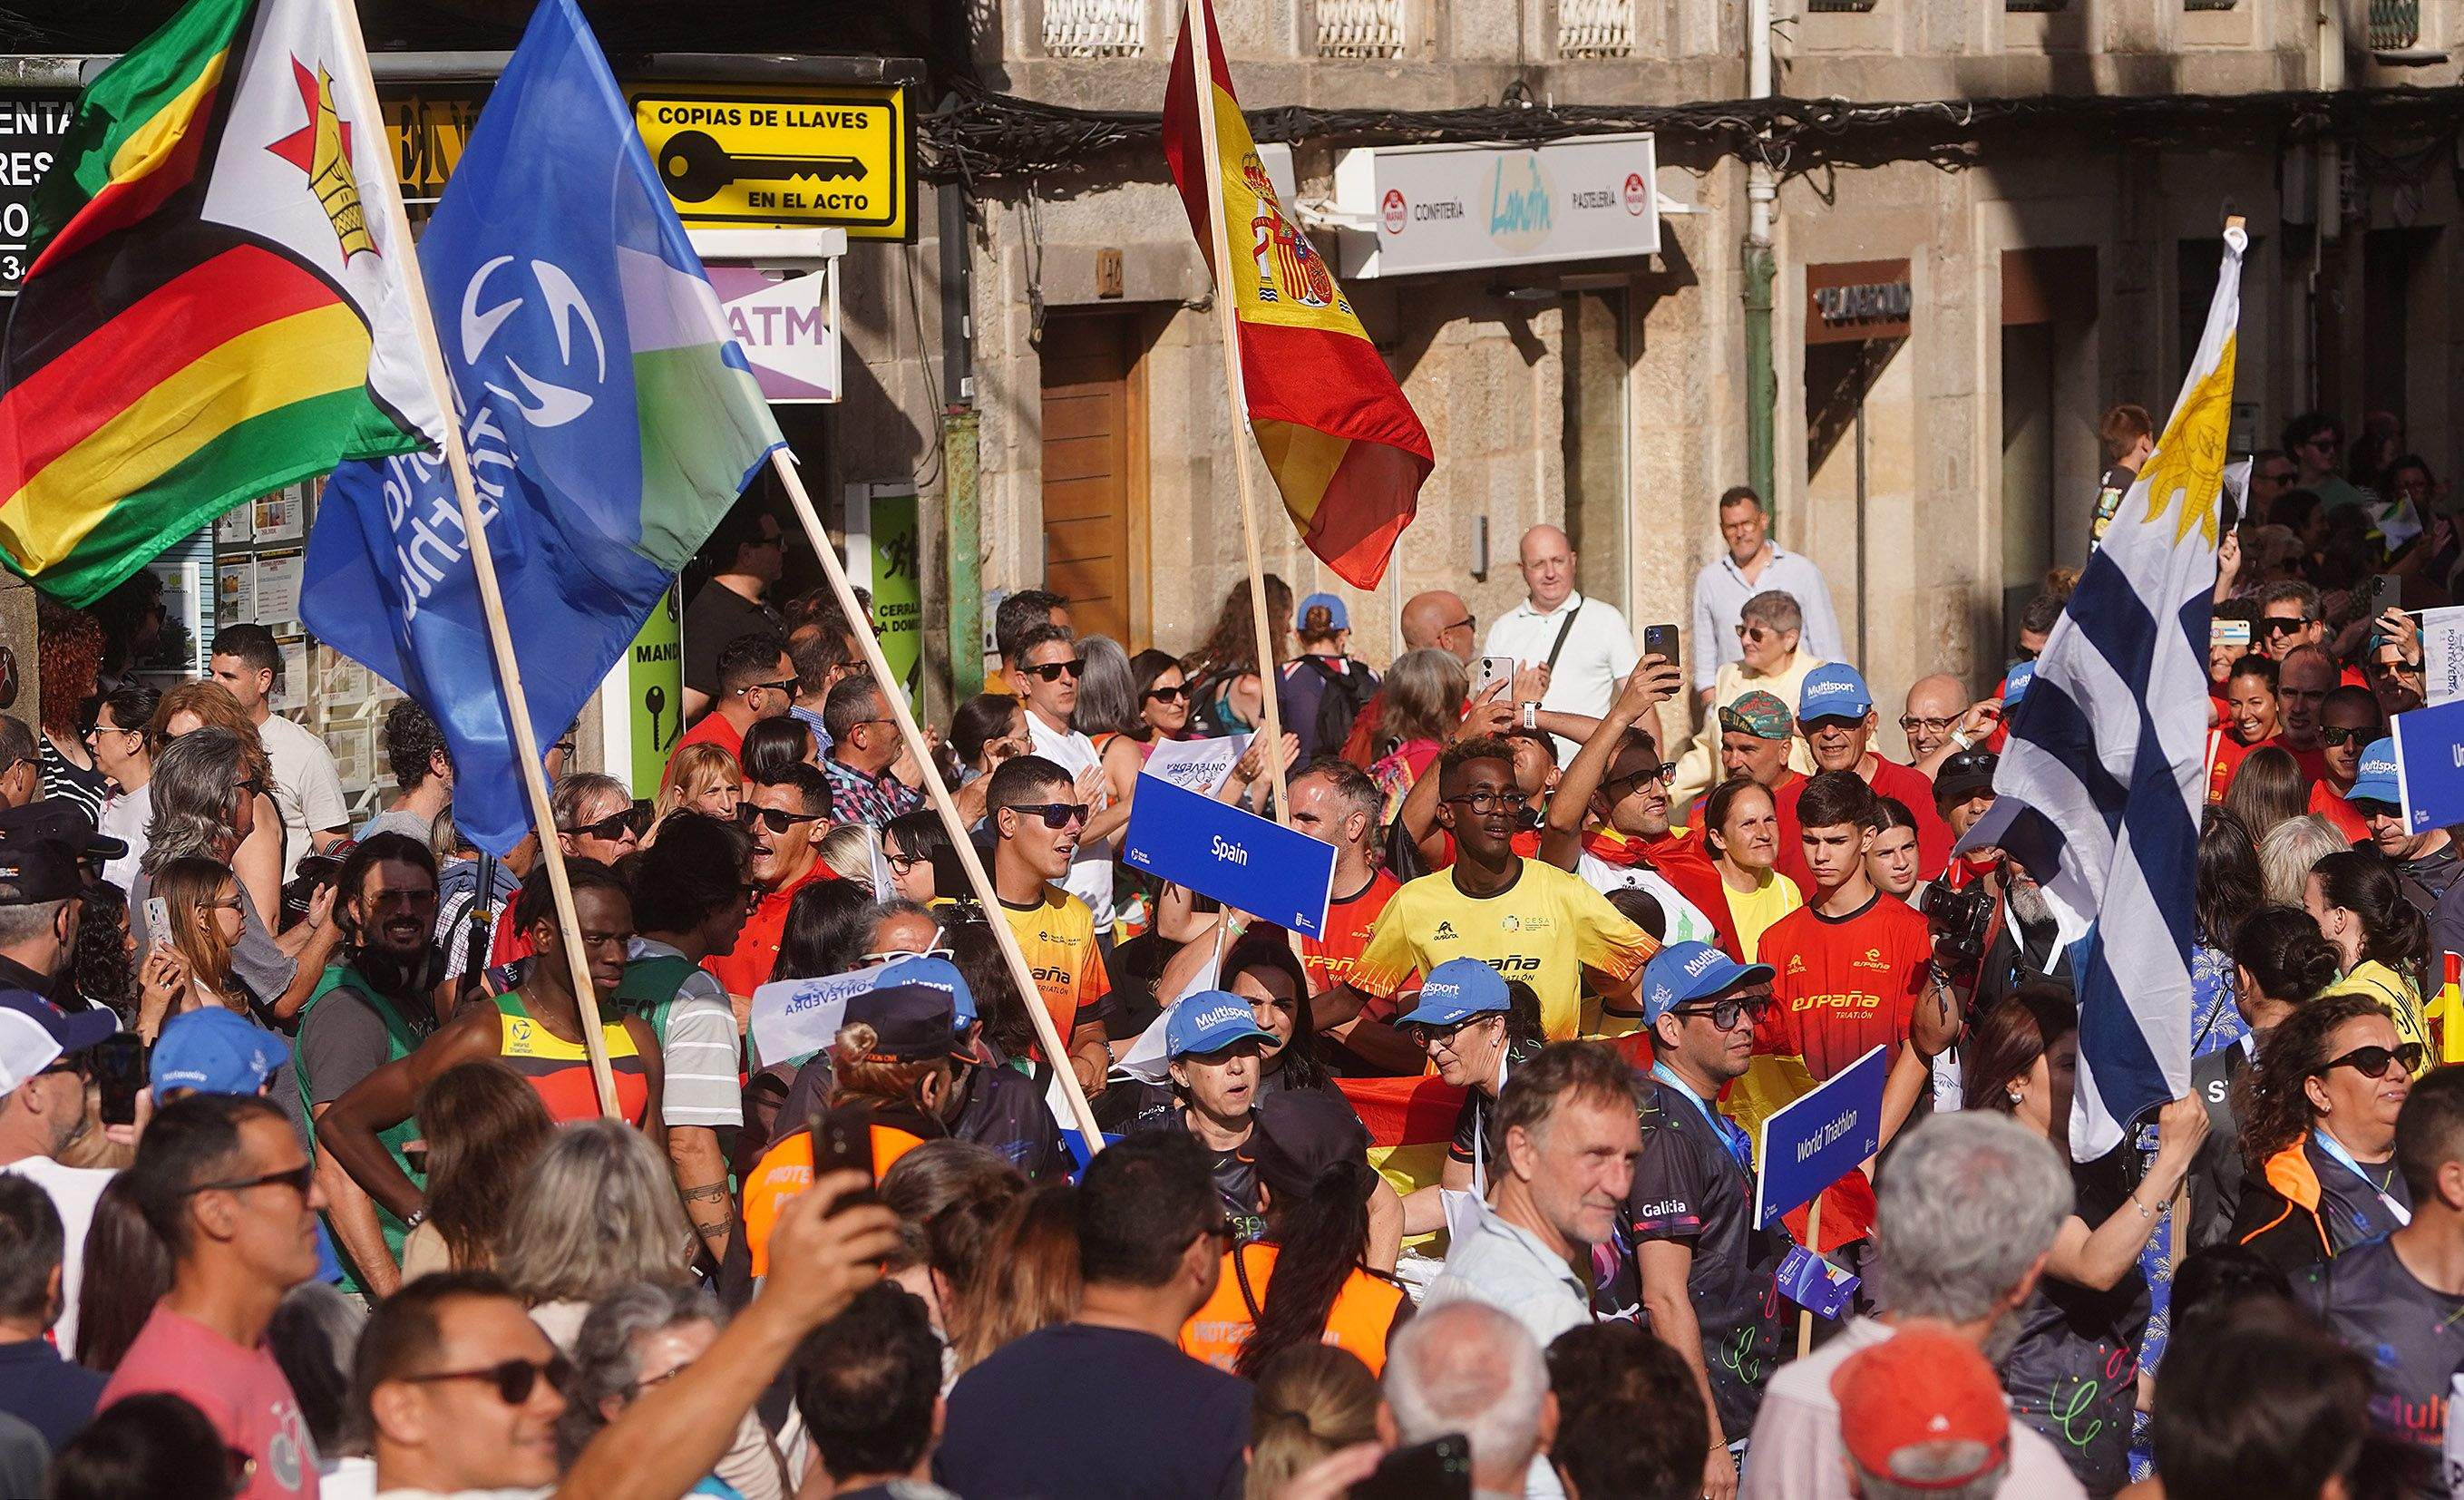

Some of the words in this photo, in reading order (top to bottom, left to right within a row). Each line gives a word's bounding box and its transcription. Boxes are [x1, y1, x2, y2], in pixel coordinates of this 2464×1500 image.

[657, 107, 742, 126] COPIAS
[749, 109, 778, 127] DE
[786, 110, 869, 129] LLAVES
[748, 191, 774, 208] EN
[783, 192, 806, 209] EL
[815, 193, 869, 210] ACTO
[729, 307, 823, 346] ATM
[636, 643, 679, 663] MAND
[1807, 680, 1855, 696] Multisport
[1166, 762, 1228, 774] ONTEVEDRA
[1211, 834, 1249, 866] Spain
[1524, 916, 1551, 924] CESA
[1481, 954, 1542, 971] aña
[1853, 959, 1891, 970] españa
[1028, 966, 1071, 985] aña
[1791, 989, 1881, 1012] españa
[1836, 1010, 1874, 1020] TRIATLÓN
[1797, 1125, 1823, 1164] World
[1824, 1108, 1857, 1146] Triathlon
[765, 1164, 813, 1186] PROTE
